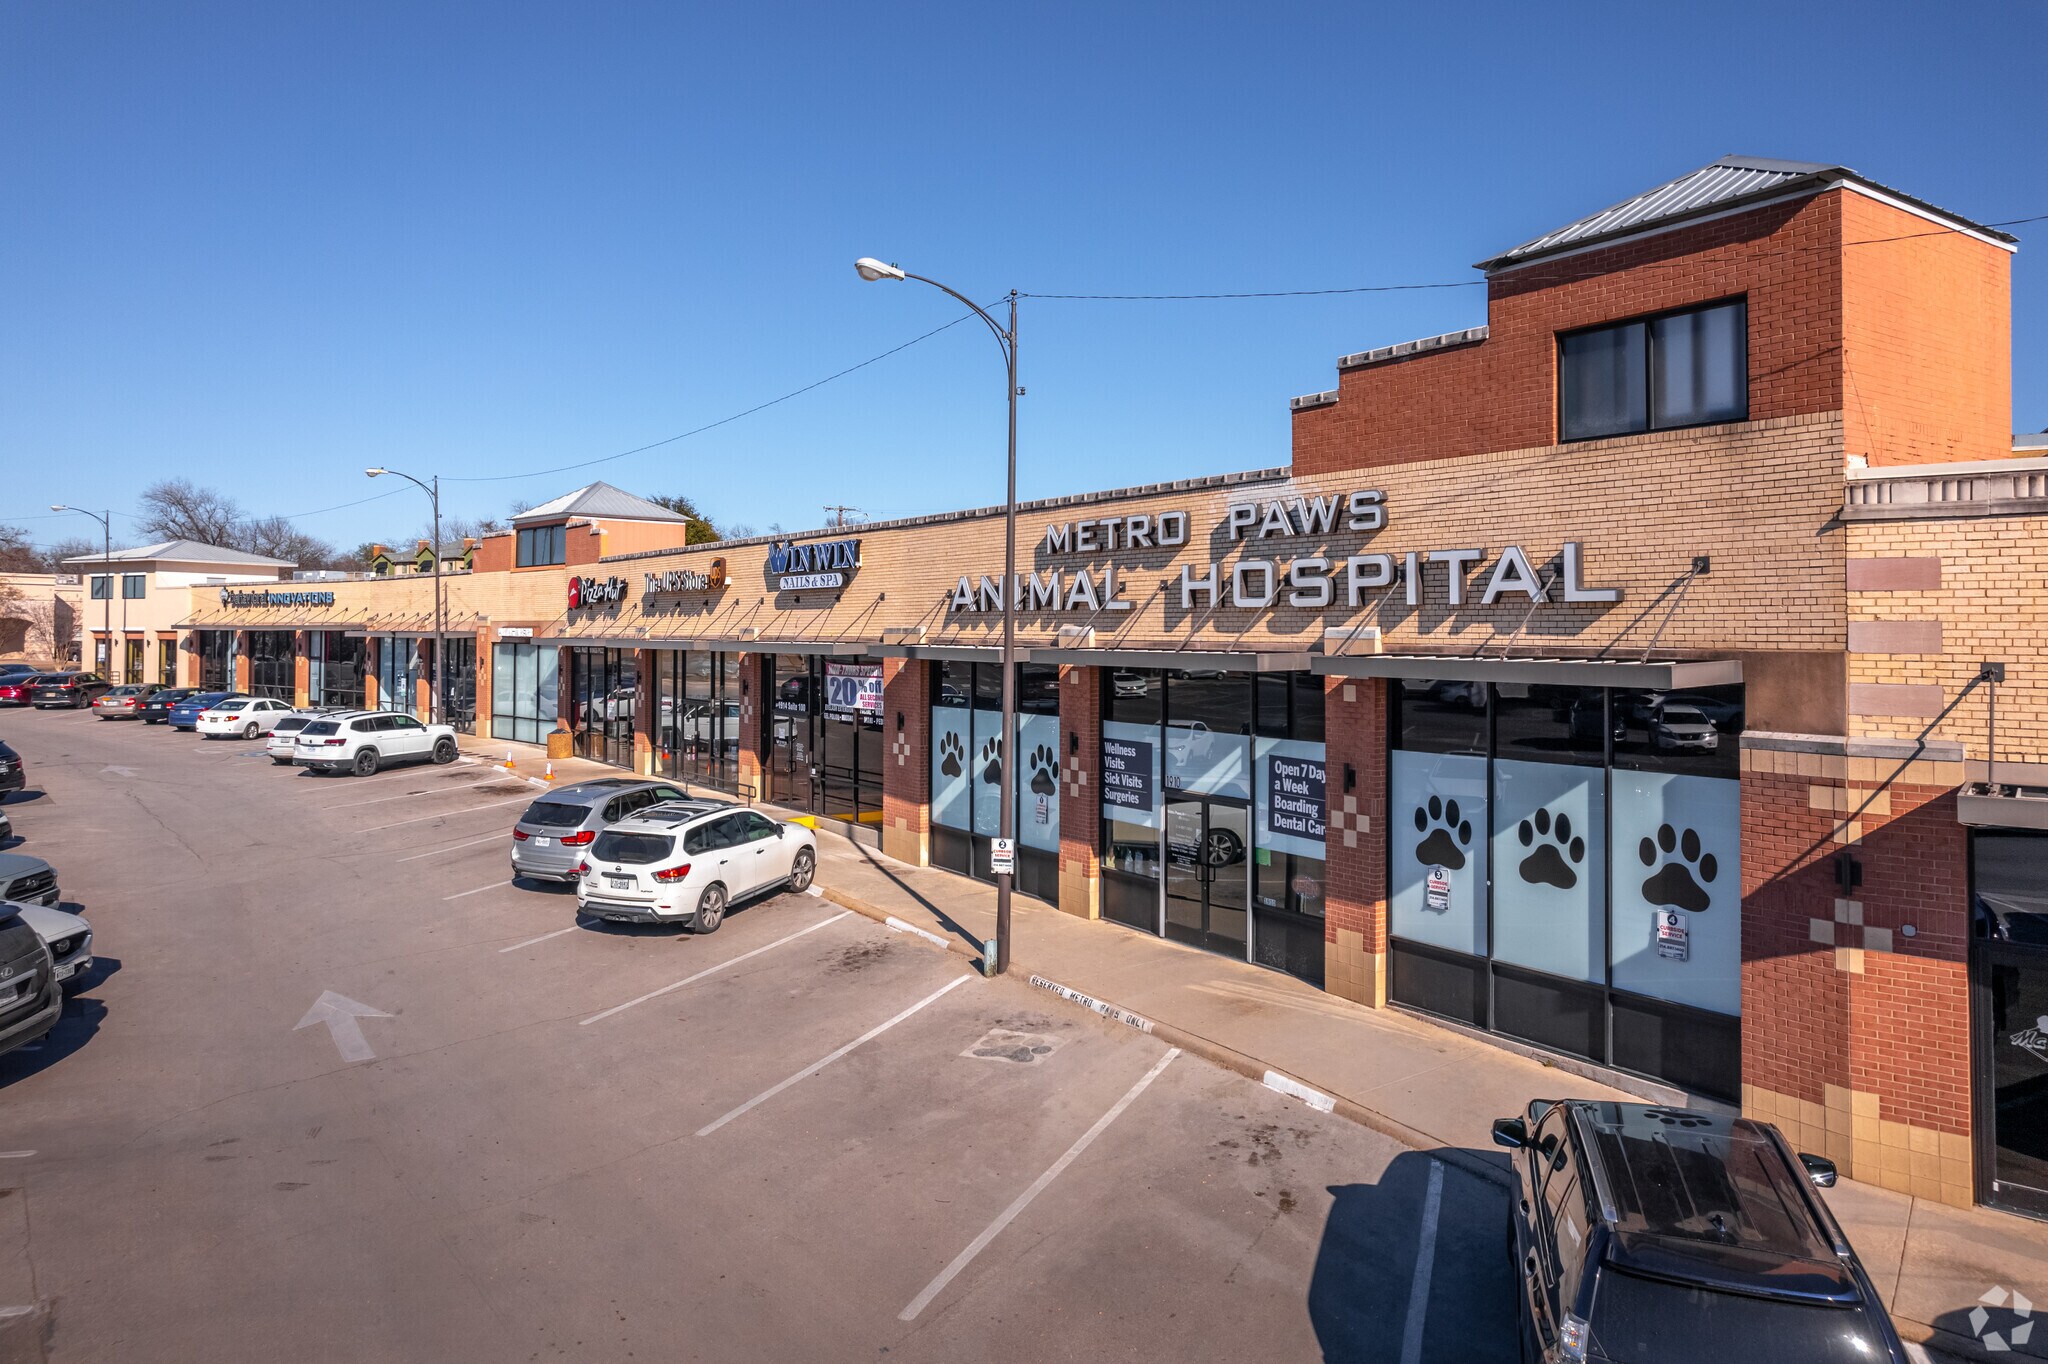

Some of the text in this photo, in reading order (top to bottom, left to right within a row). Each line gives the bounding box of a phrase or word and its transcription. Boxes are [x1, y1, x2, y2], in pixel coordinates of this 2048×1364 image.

[1047, 490, 1382, 554] METRO PAWS
[814, 540, 857, 570] WIN
[645, 570, 708, 592] The UPS Store
[783, 574, 839, 589] NAILS & SPA
[951, 542, 1618, 611] ANIMAL HOSPITAL
[269, 591, 334, 604] INNOVATIONS
[580, 578, 624, 603] Pizza Hut
[869, 680, 882, 693] off
[862, 701, 882, 709] SERVICES
[1104, 742, 1136, 757] Wellness
[1104, 756, 1125, 770] Visits
[1274, 760, 1300, 778] Open
[1301, 764, 1307, 777] 7
[1104, 771, 1143, 788] Sick Visits
[1166, 775, 1181, 788] 1910
[1274, 778, 1309, 795] a Week
[1104, 788, 1140, 804] Surgeries
[1274, 795, 1319, 818] Boarding
[1274, 814, 1326, 836] Dental Car
[1660, 925, 1684, 934] CURBSIDE
[1031, 976, 1065, 996] RESERVED
[1069, 991, 1093, 1008] METRO
